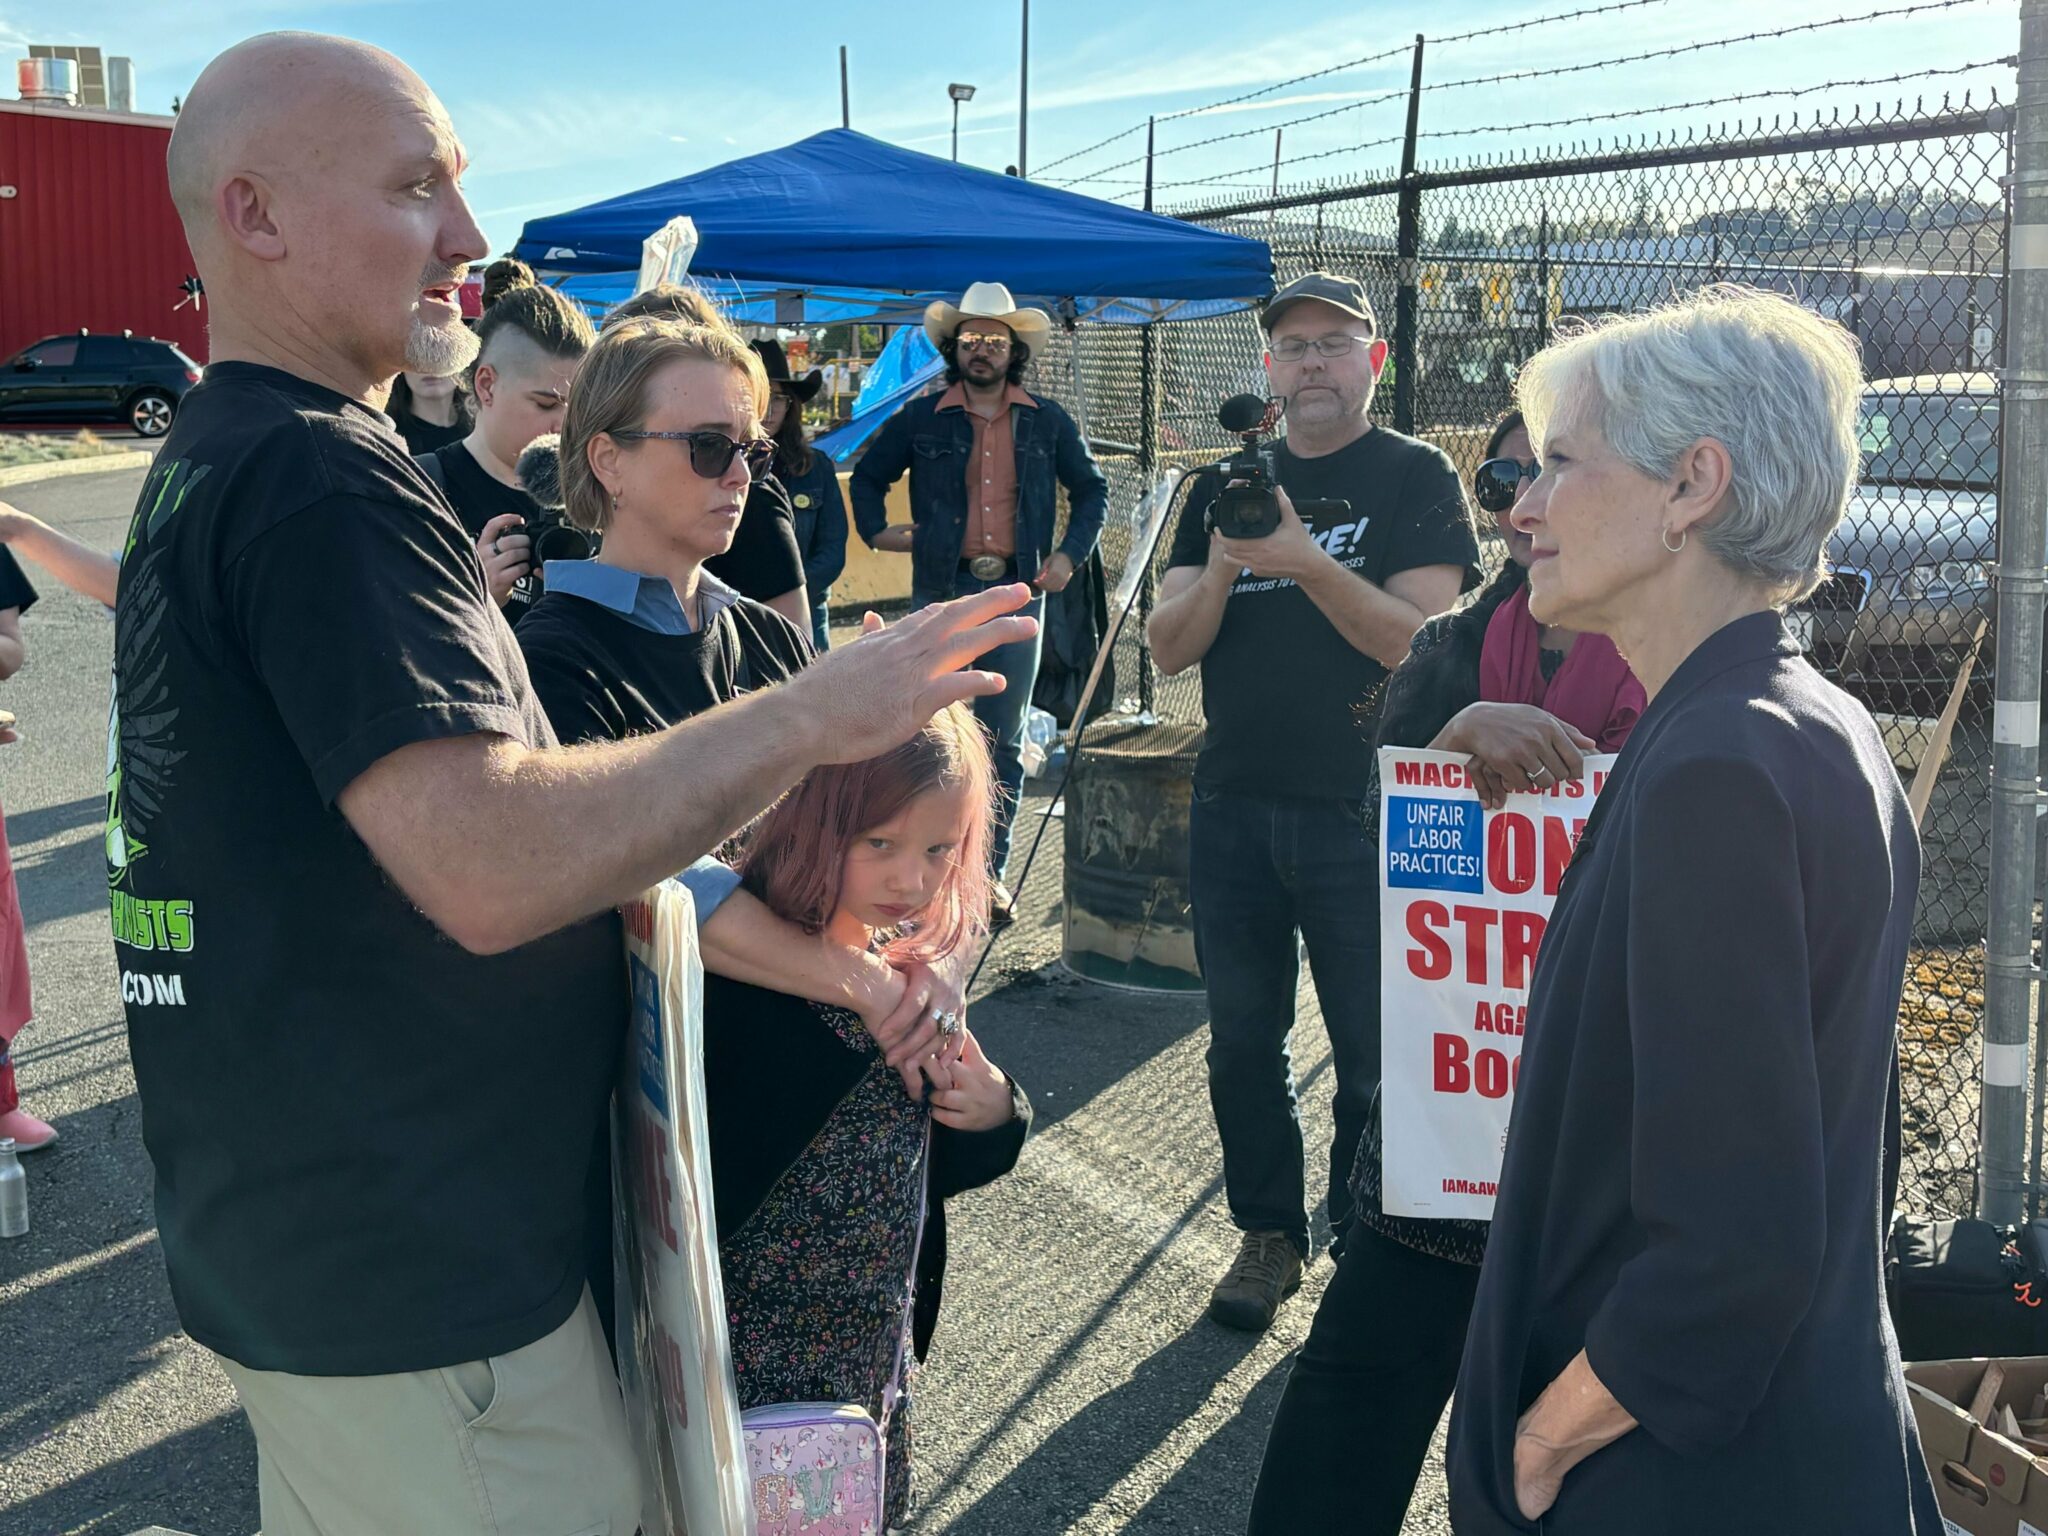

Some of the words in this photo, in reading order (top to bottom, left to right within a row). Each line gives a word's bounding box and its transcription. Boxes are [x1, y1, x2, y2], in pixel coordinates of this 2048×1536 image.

[1234, 579, 1277, 594] ANALYSIS
[1407, 803, 1464, 826] UNFAIR
[1409, 829, 1462, 850] LABOR
[1390, 851, 1480, 877] PRACTICES!
[122, 969, 187, 1006] COM
